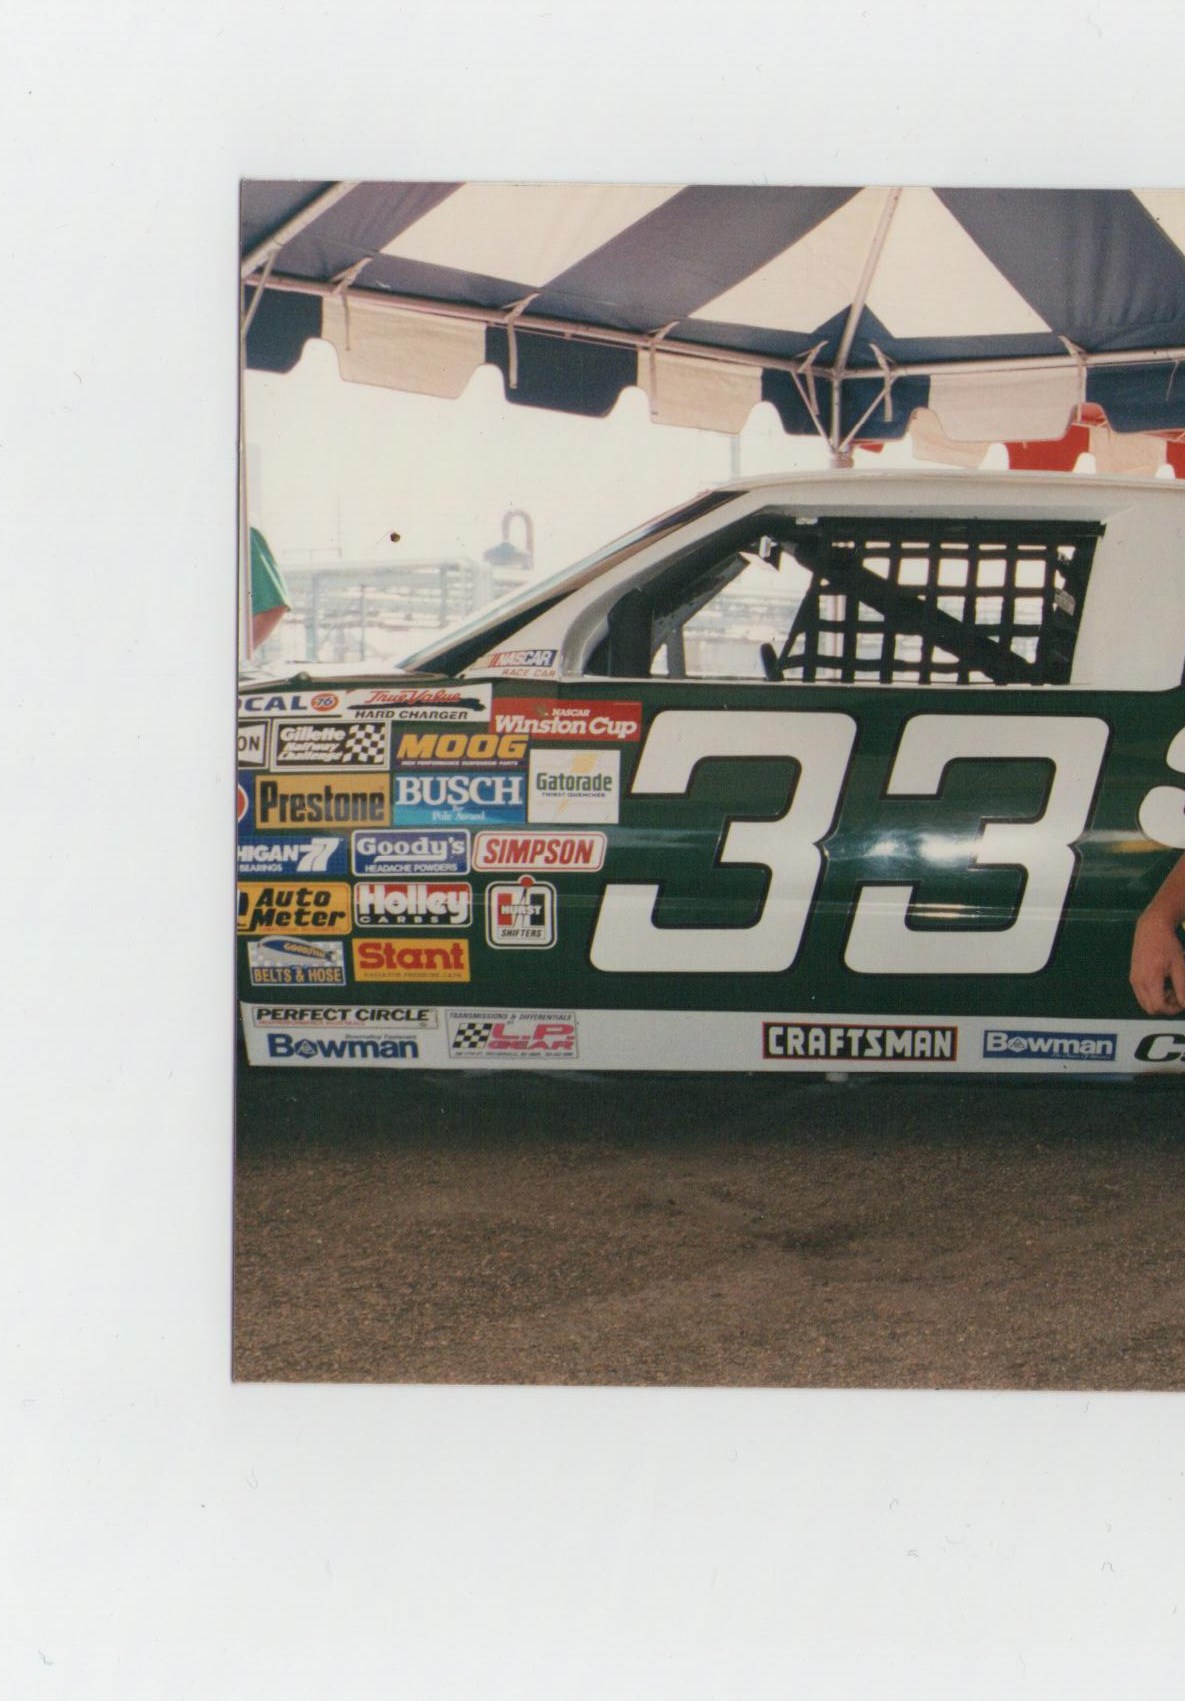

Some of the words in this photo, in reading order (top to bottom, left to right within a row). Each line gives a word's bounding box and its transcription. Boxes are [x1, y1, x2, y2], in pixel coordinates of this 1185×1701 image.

[499, 650, 555, 667] NASCAR
[502, 669, 529, 677] RACE
[534, 669, 556, 677] CAR
[238, 696, 307, 711] CAL
[318, 697, 333, 706] 76
[355, 711, 395, 719] HARD
[400, 710, 468, 720] CHARGER
[552, 709, 591, 717] NASCAR
[280, 726, 346, 742] Gillette
[495, 715, 587, 734] Winston
[588, 716, 638, 739] Cup
[397, 733, 529, 760] MOOG
[396, 776, 523, 806] BUSCH
[536, 772, 613, 792] Gatorade
[260, 780, 385, 823] Prestone
[356, 836, 466, 862] Goody's
[483, 838, 595, 865] SIMPSON
[589, 709, 1110, 974] 33
[364, 863, 412, 874] HEADACHE
[413, 862, 458, 873] POWDERS
[254, 888, 331, 908] Auto
[359, 884, 469, 924] Holley
[249, 907, 346, 932] Meter
[359, 915, 438, 924] CARBS
[501, 904, 542, 916] HURST
[501, 929, 542, 938] SHIFTERS
[357, 942, 465, 970] Stant
[253, 967, 291, 983] BELTS
[309, 967, 342, 982] HOSE
[256, 1008, 350, 1021] PERFECT
[355, 1009, 430, 1021] CIRCLE
[267, 1033, 419, 1059] Bowman
[487, 1040, 574, 1050] GEAR
[768, 1026, 952, 1059] CRAFTSMAN
[987, 1032, 1113, 1055] Bowman
